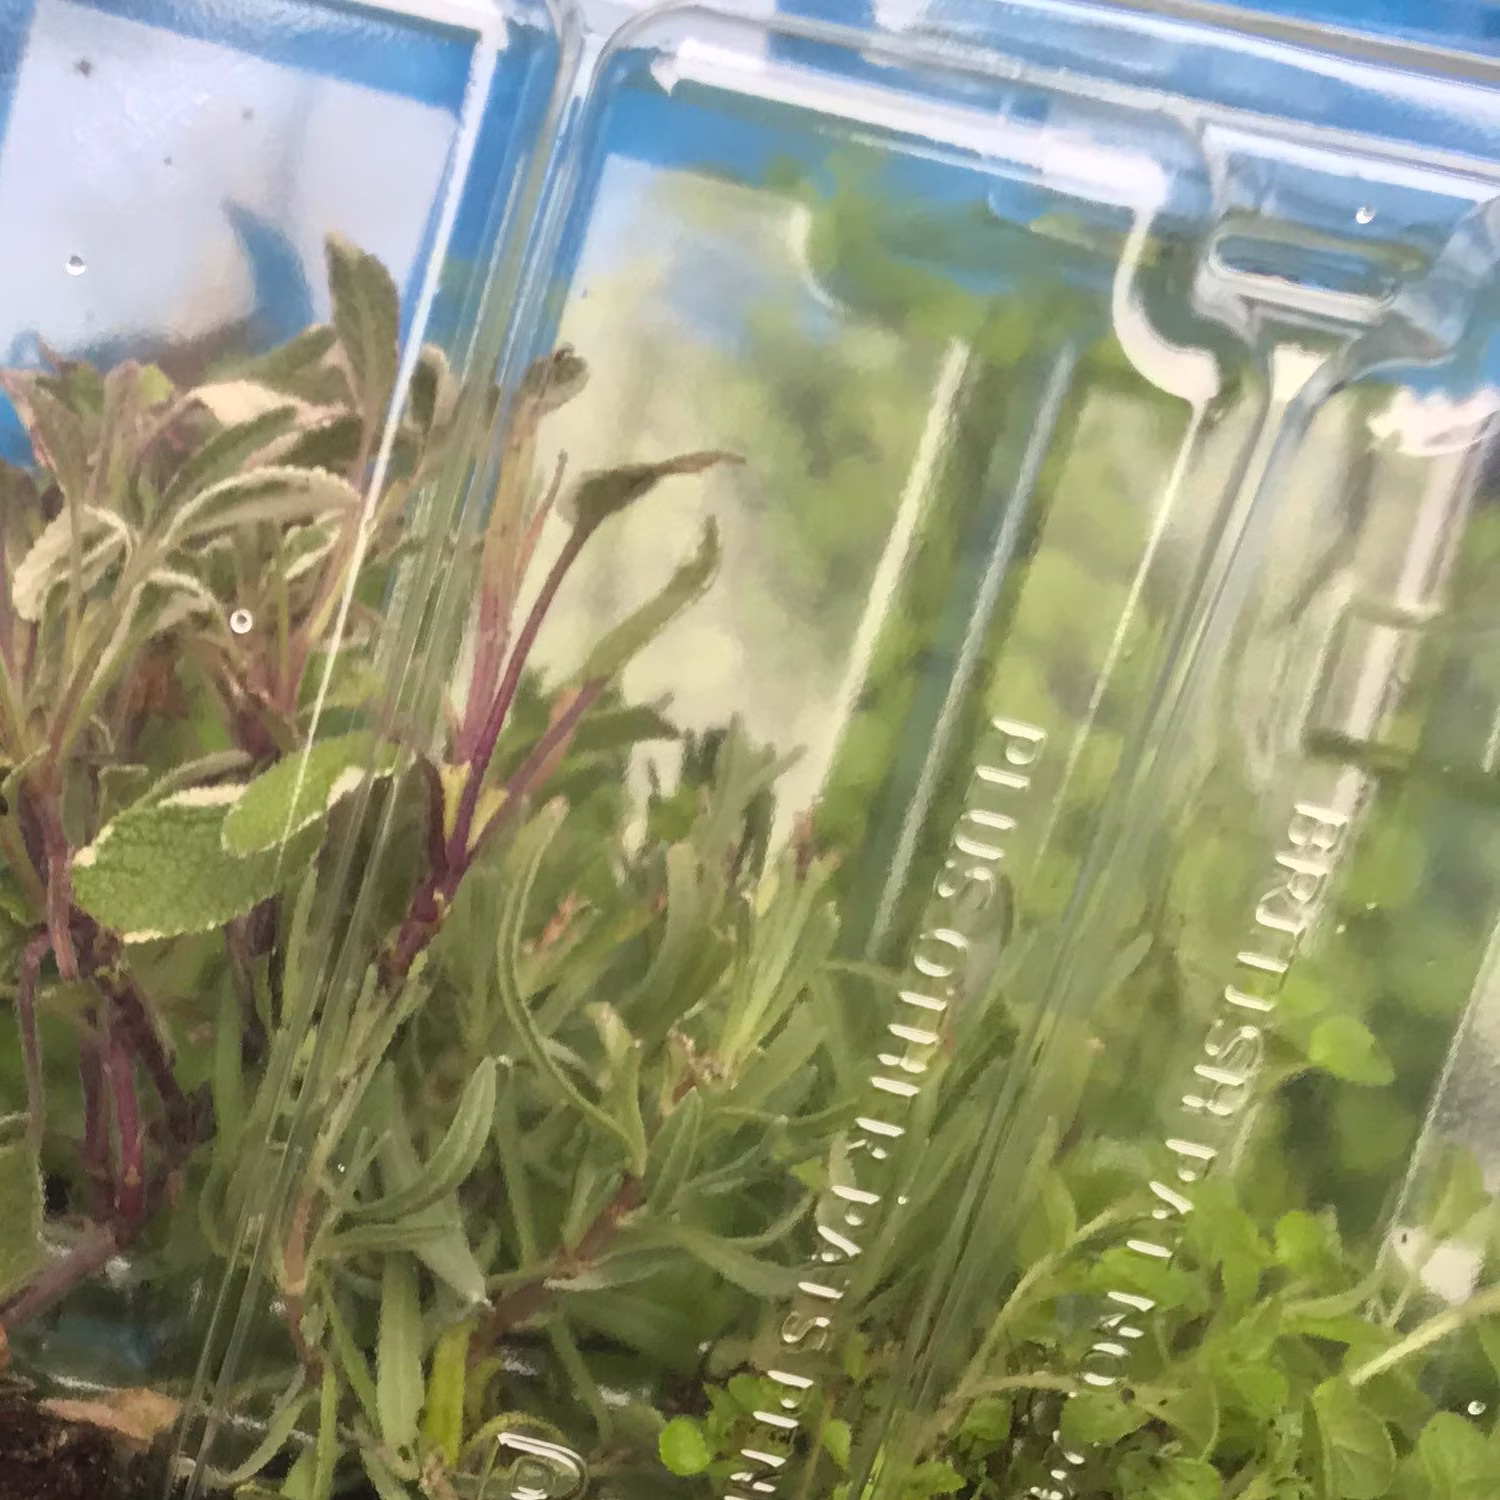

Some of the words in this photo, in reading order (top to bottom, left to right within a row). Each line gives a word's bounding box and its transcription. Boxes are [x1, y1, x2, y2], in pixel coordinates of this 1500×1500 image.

[932, 716, 1049, 912] PLUS
[845, 927, 970, 1162] OTHER
[1180, 801, 1350, 1118] BRITISH
